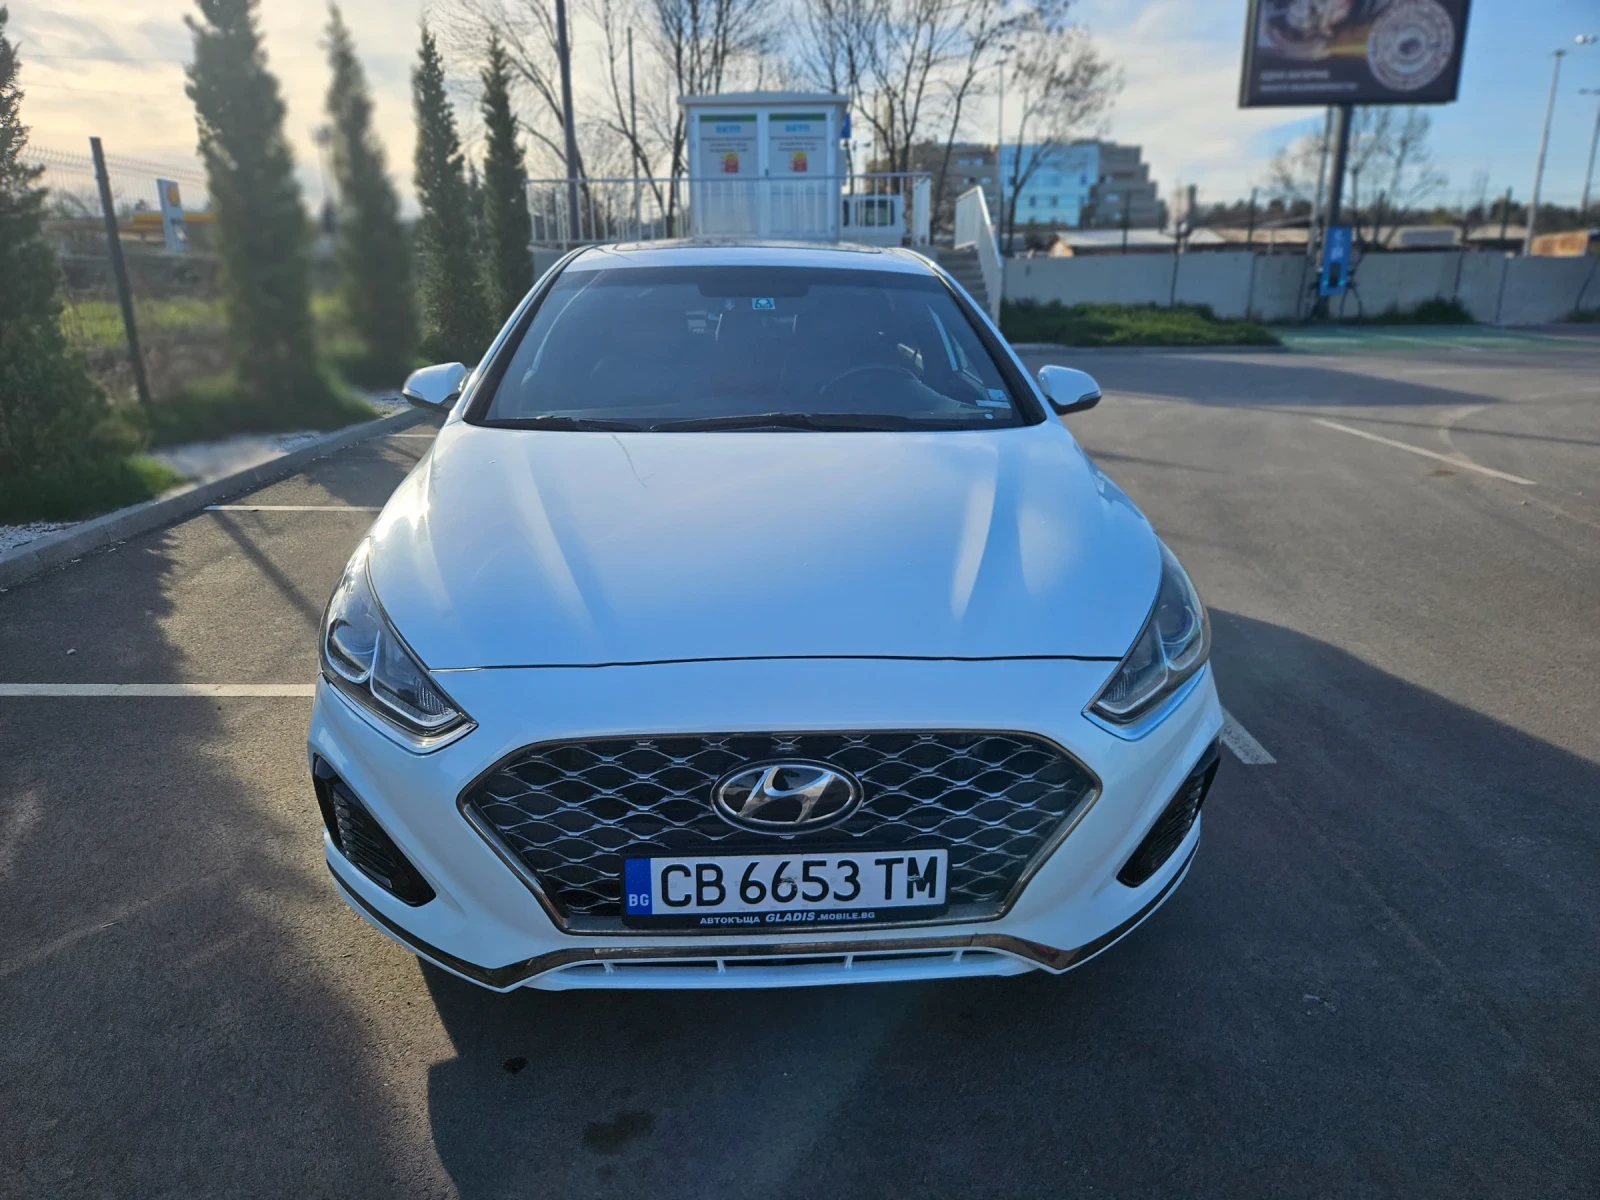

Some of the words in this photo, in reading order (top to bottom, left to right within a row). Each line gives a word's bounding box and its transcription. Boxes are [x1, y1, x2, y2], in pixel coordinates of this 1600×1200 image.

[739, 859, 861, 905] 6653
[628, 893, 650, 907] BG
[700, 916, 761, 925] АВТОКЪЩА
[765, 911, 816, 923] GLADIS
